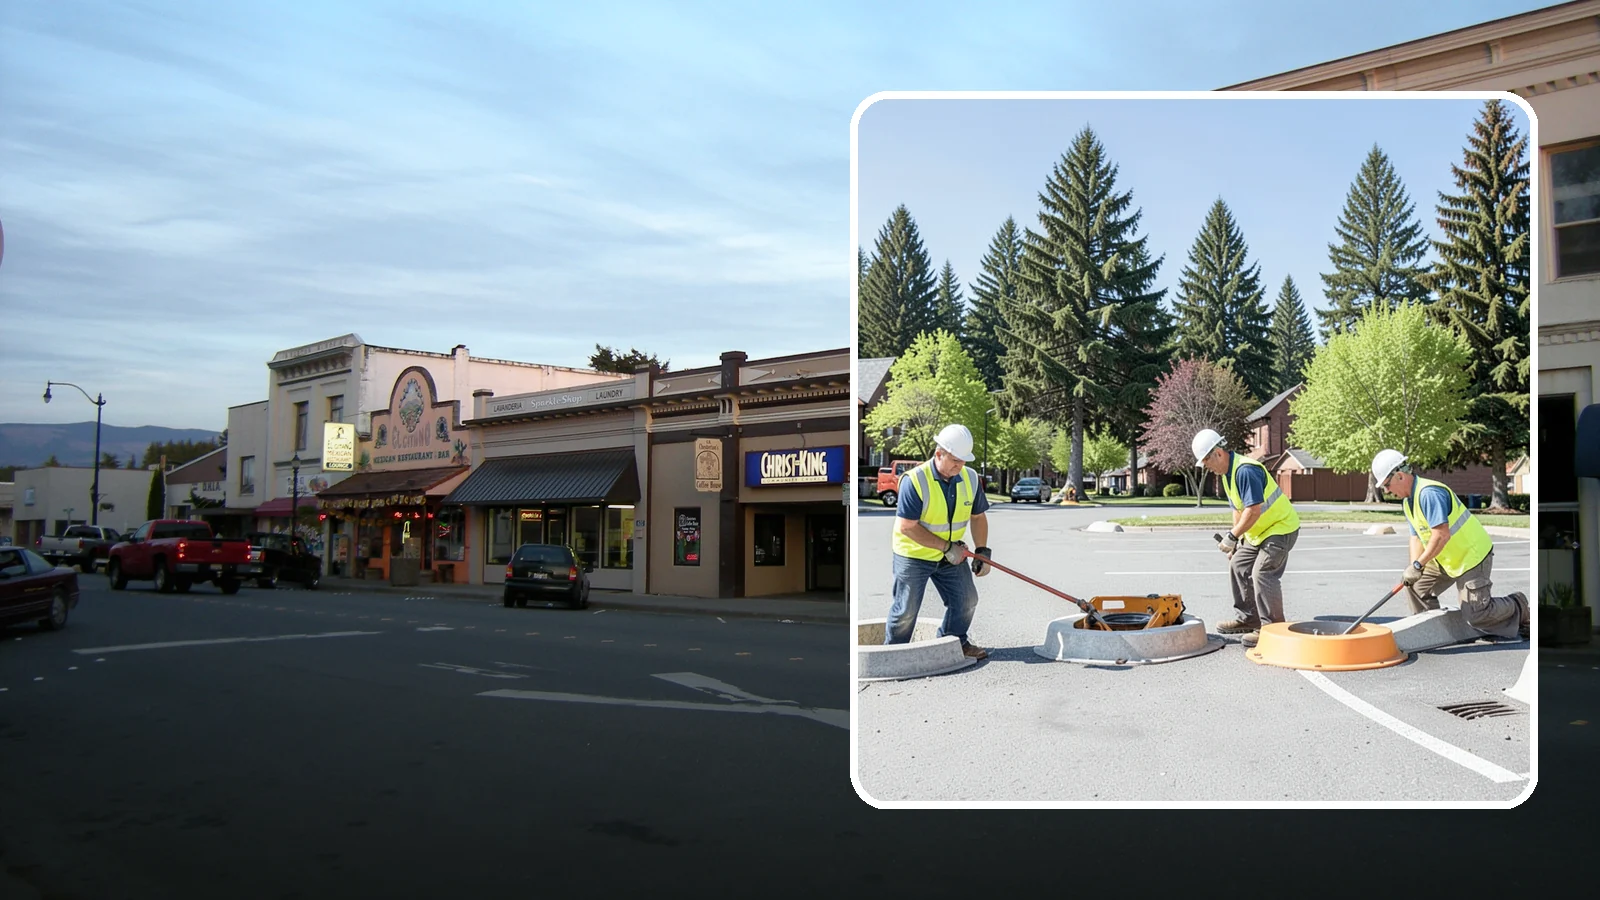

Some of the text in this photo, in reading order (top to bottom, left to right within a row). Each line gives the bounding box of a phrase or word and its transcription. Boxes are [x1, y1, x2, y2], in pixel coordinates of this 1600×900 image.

[595, 388, 624, 400] LAUNDRY
[493, 402, 522, 413] LAVANDERIA
[373, 449, 450, 464] MEXICAN RESTAURANT BAR
[760, 450, 827, 478] CHRIST KING
